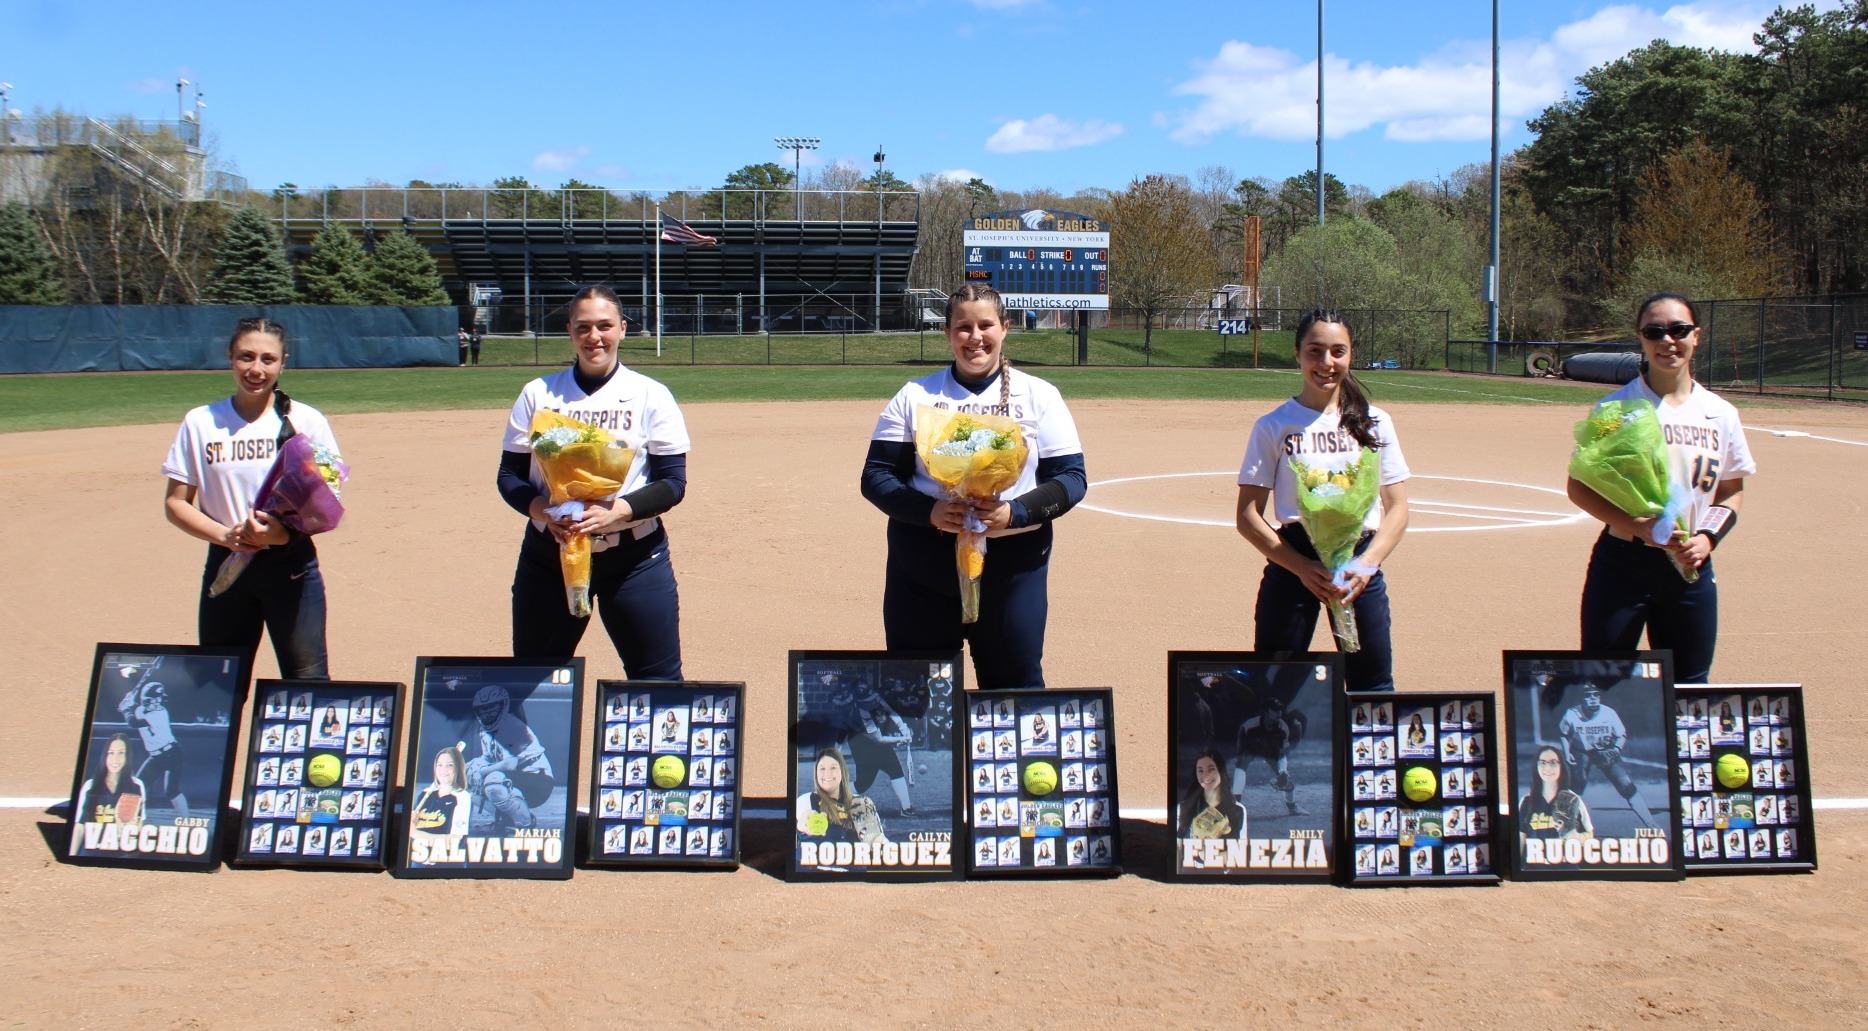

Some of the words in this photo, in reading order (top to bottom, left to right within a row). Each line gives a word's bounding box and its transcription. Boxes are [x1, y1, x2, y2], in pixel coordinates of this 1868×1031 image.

[974, 218, 1020, 231] GOLDEN
[1057, 219, 1100, 232] EAGLES
[969, 255, 983, 263] BAT
[1009, 251, 1027, 259] BALL
[1040, 251, 1065, 259] STRIKE
[1065, 249, 1072, 261] 0
[1084, 252, 1099, 260] OUT
[1220, 320, 1247, 335] 214
[1284, 433, 1307, 456] ST.
[1663, 423, 1720, 452] OSEPH'S
[206, 442, 226, 465] ST.
[231, 438, 275, 462] JOSEP
[1691, 454, 1720, 493] 15
[551, 669, 571, 684] 10
[1315, 664, 1327, 681] 3
[1640, 662, 1662, 679] 15
[174, 816, 211, 827] GABBY
[84, 821, 209, 856] VACCHIO
[514, 828, 561, 838] MARIAH
[908, 831, 952, 842] CAILYN
[1289, 829, 1325, 839] EMILY
[1634, 827, 1667, 839] JULIA
[411, 836, 562, 864] SALVATTO
[800, 841, 952, 866] RODRIGUEZ
[1182, 838, 1329, 868] FENEZIA
[1525, 837, 1669, 865] RUOCCHIO
